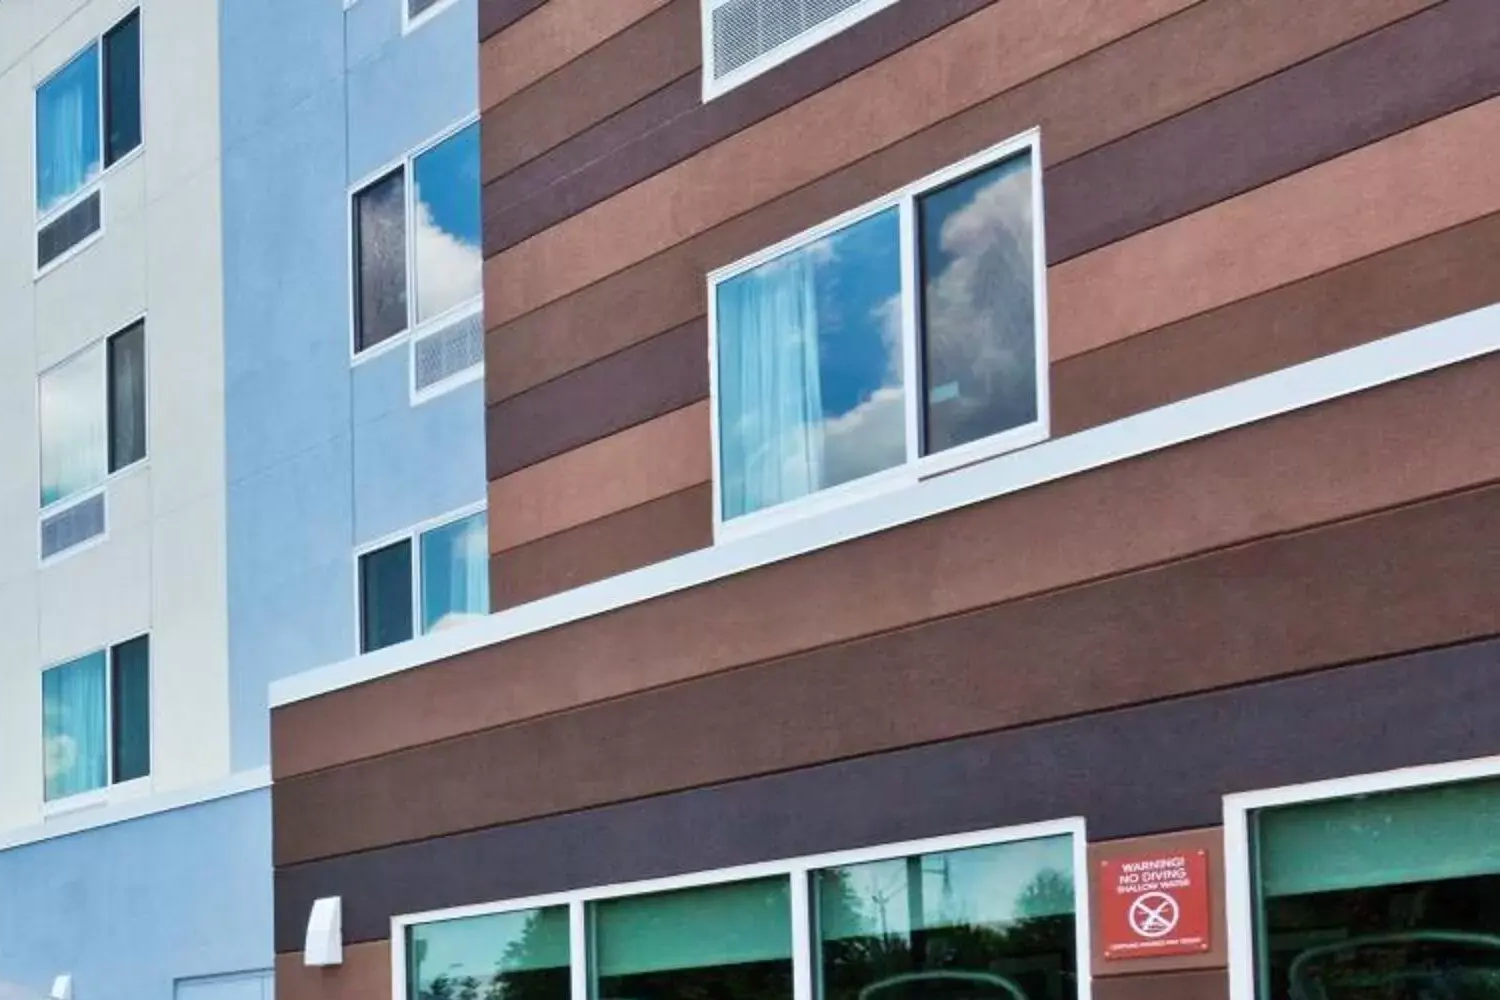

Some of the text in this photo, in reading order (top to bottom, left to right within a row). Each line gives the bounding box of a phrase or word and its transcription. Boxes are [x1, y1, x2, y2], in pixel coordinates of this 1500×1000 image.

[1121, 856, 1185, 873] WARNING!
[1119, 868, 1188, 885] NO DIVING
[1117, 882, 1159, 895] SHALLOW
